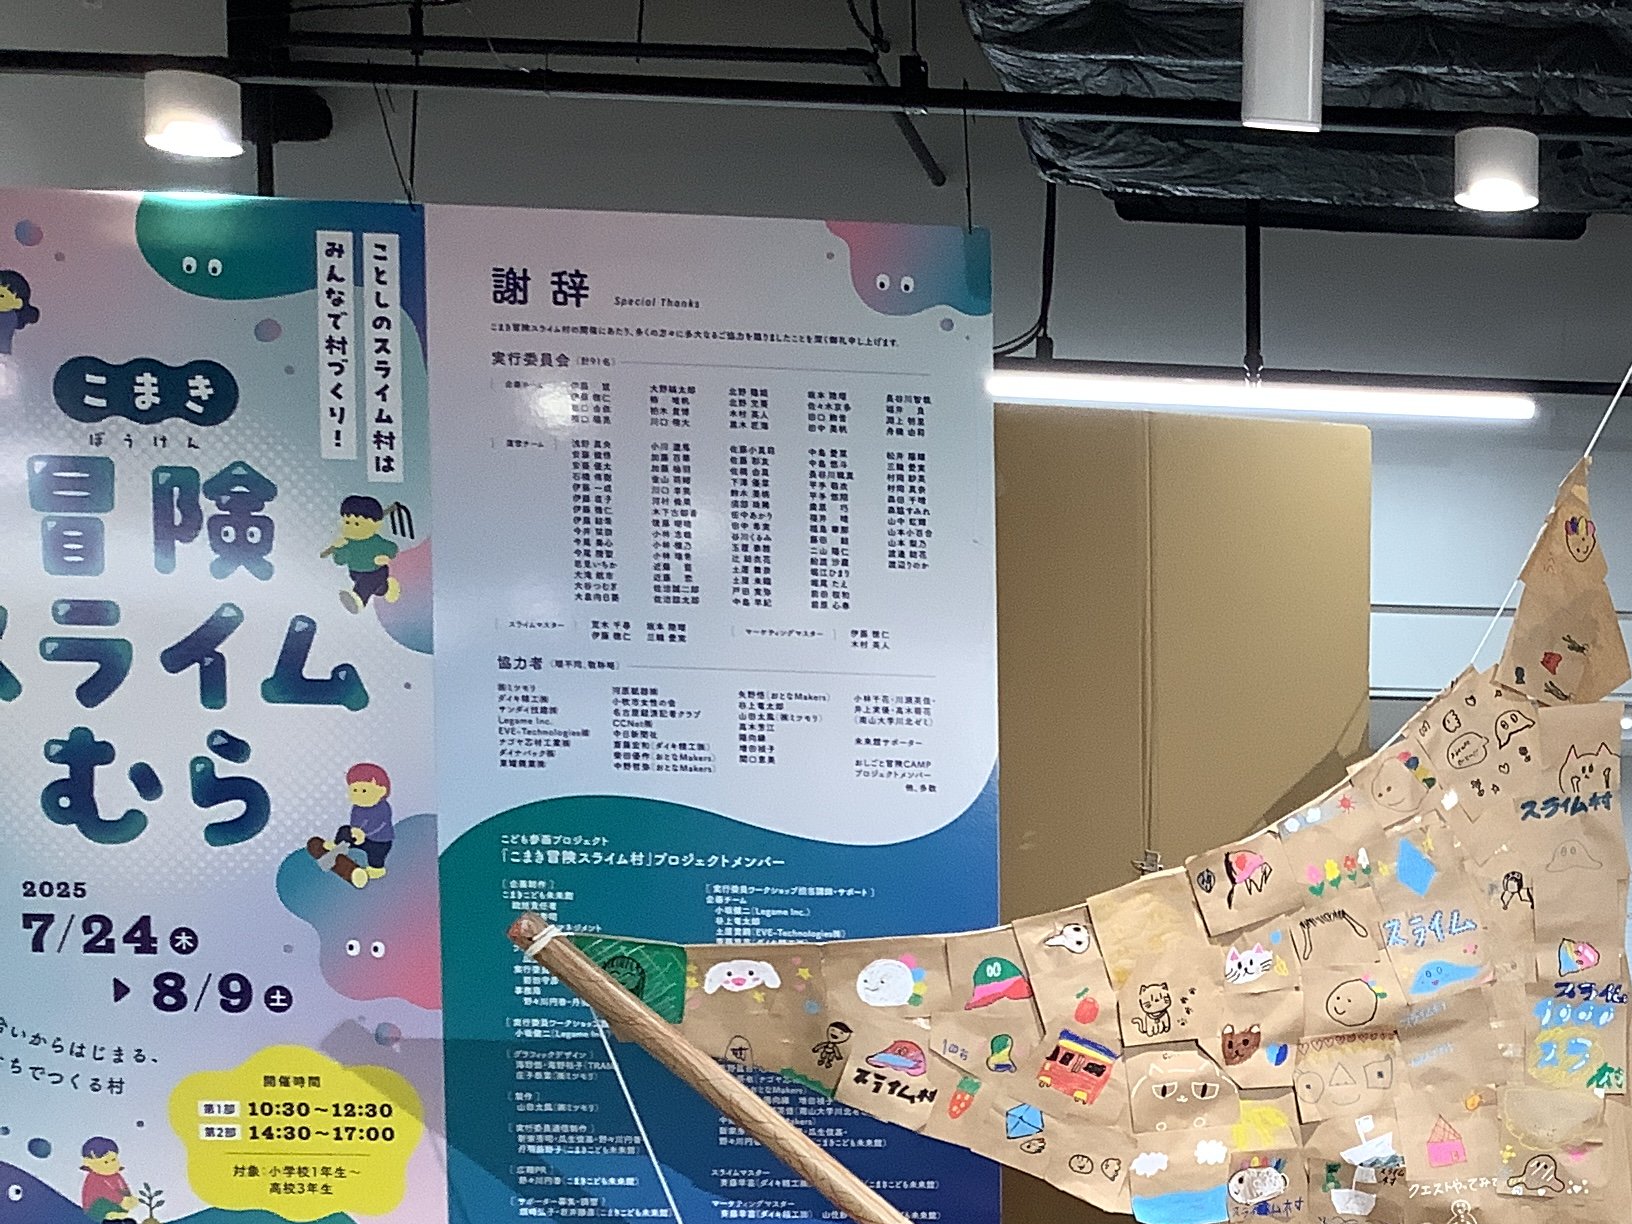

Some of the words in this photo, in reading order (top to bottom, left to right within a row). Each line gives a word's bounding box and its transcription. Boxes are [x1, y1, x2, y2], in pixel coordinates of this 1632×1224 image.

[491, 266, 590, 309] 謝辞
[614, 295, 657, 309] Special
[660, 296, 700, 310] Thanks
[325, 241, 350, 448] みんなで村づくり！
[371, 242, 396, 473] ことしのスライム村は
[491, 351, 571, 368] 実行委員会
[83, 371, 215, 414] こまき
[88, 432, 201, 450] ぼうけん
[26, 455, 279, 581] 冒険
[0, 600, 370, 712] ライム
[497, 655, 543, 670] 協力者
[40, 726, 272, 847] むら
[1520, 791, 1613, 822] スライム村
[21, 881, 88, 899] 2025
[21, 912, 159, 955] 7/24
[169, 925, 200, 956] 木
[1383, 908, 1478, 947] スライム
[151, 971, 254, 1014] 8/9
[263, 983, 294, 1014] 土
[0, 1055, 126, 1096] ちでつくる村
[263, 1075, 321, 1089] 開催時間
[269, 1182, 334, 1196] 高校3年生
